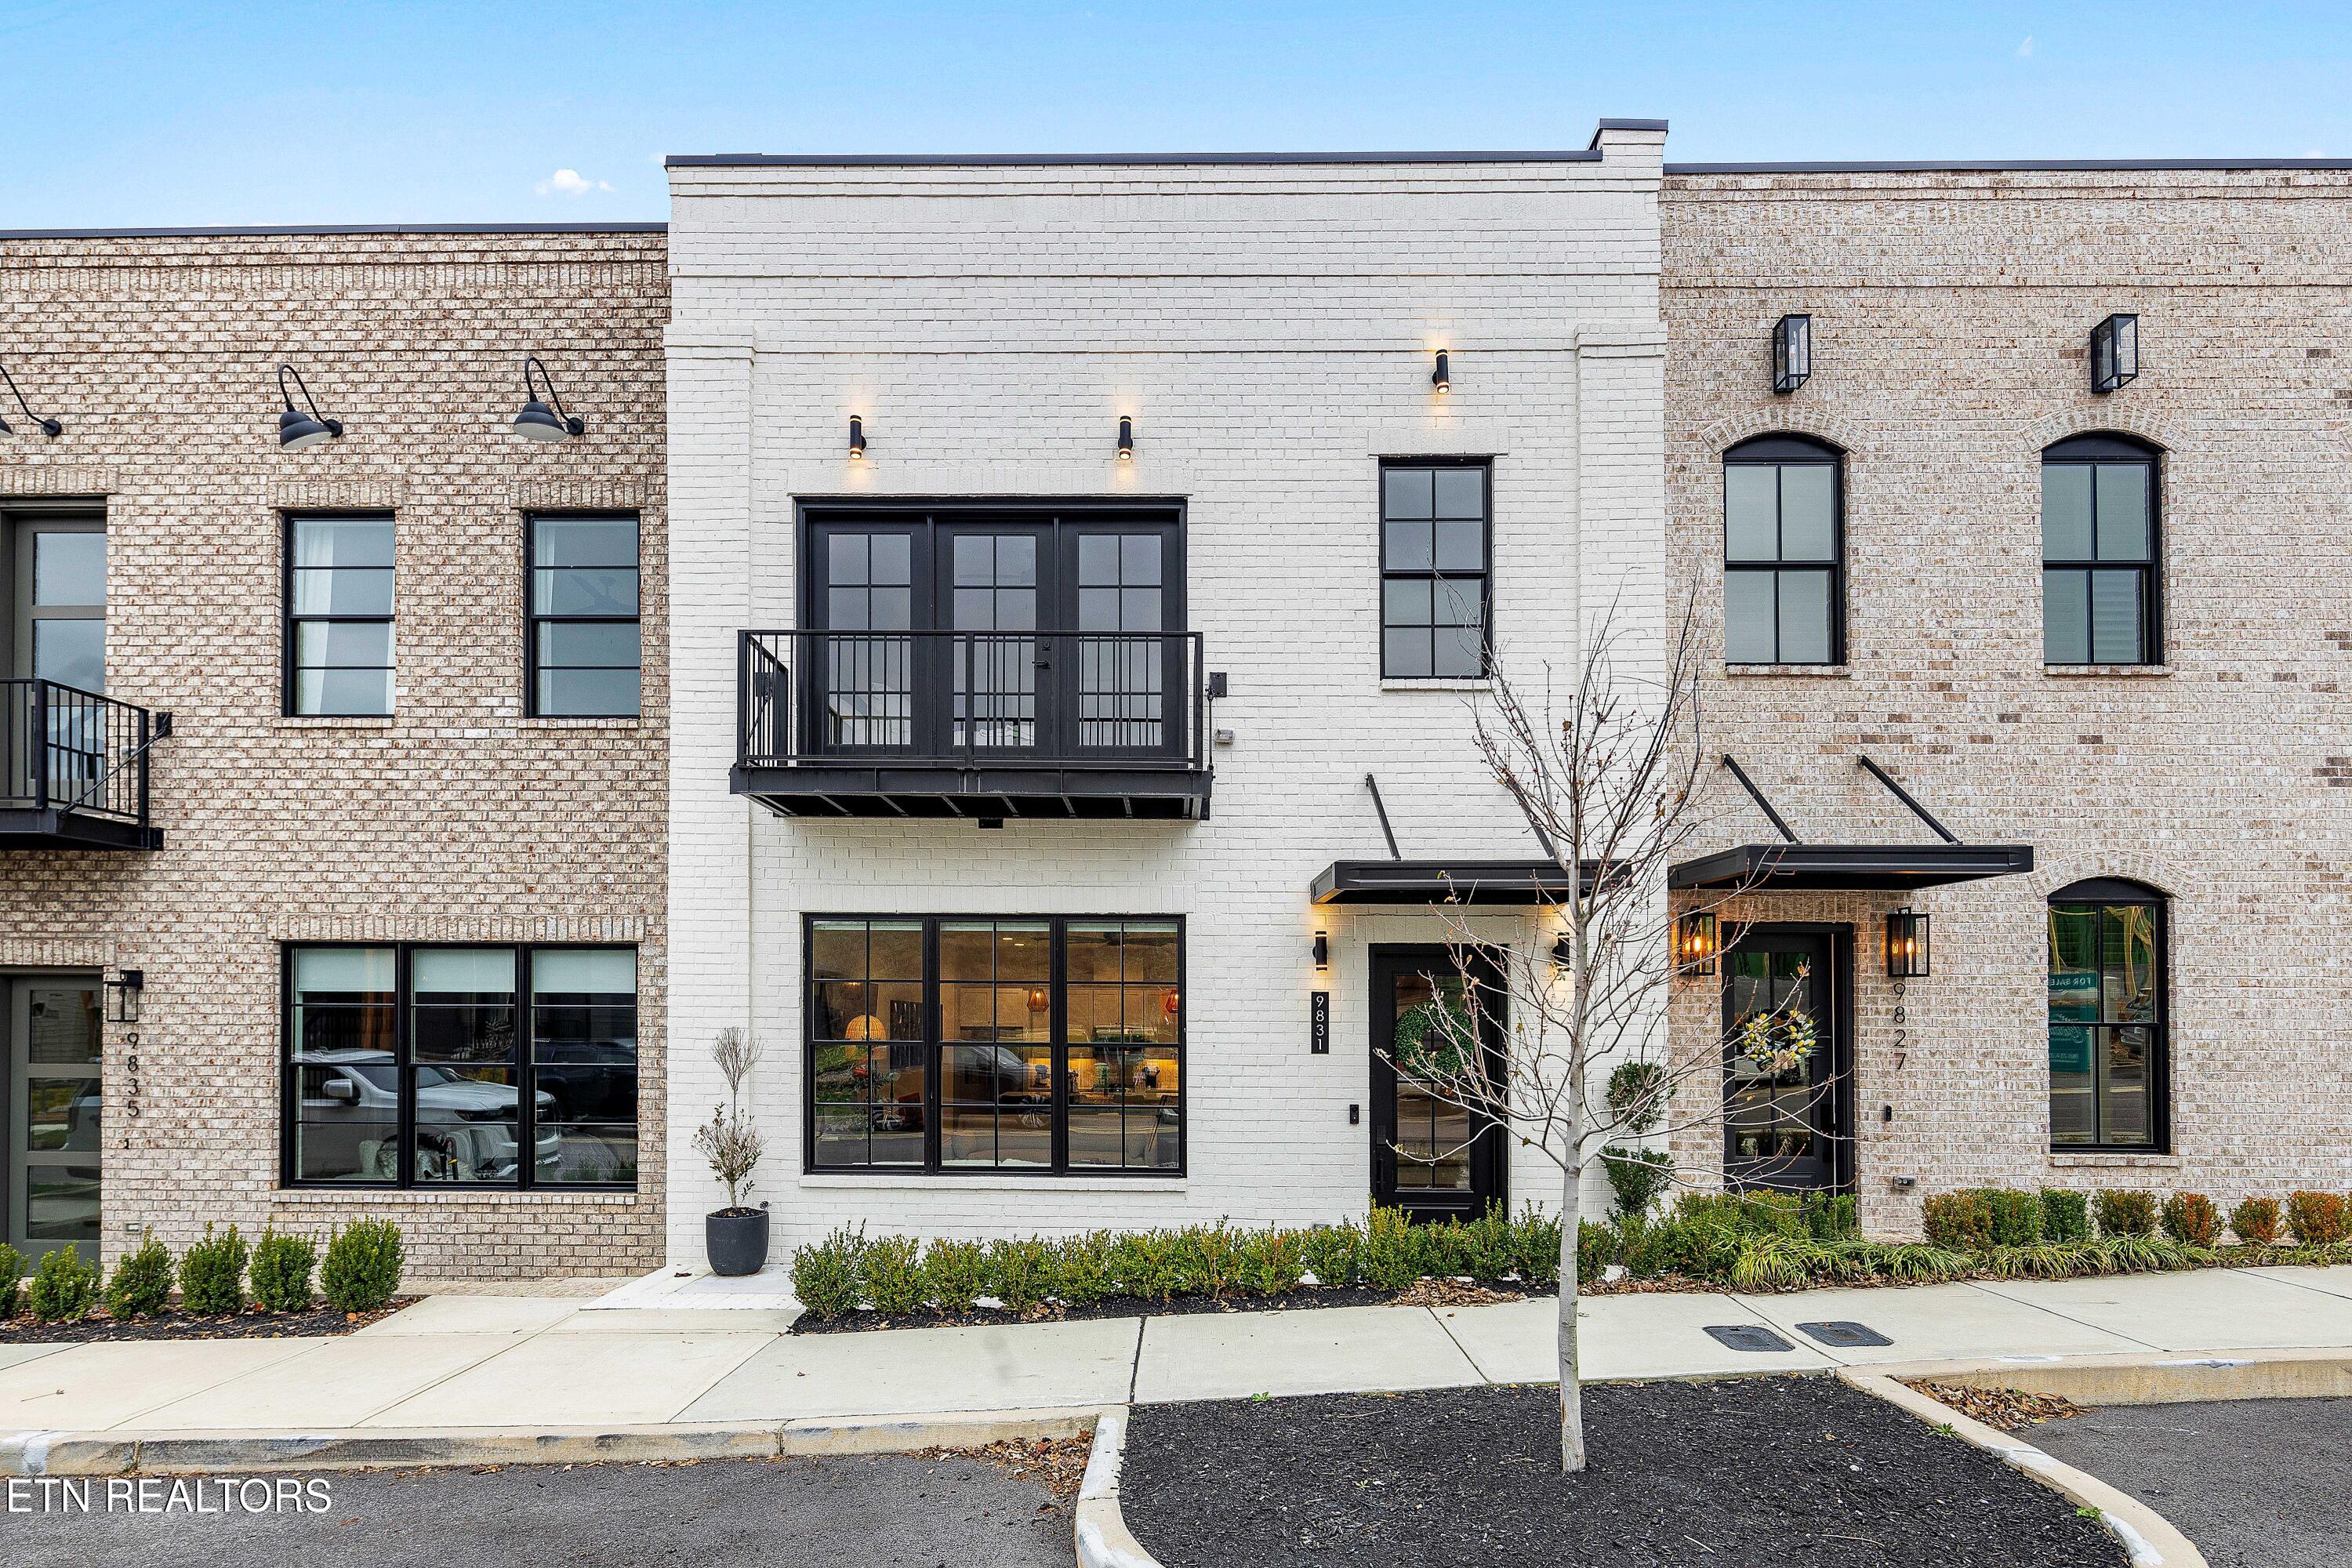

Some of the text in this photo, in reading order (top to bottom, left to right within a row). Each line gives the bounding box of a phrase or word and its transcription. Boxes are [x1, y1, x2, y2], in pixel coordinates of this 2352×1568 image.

[1316, 995, 1325, 1051] 9831
[1893, 982, 1907, 1070] 9827
[127, 1033, 139, 1116] 9835
